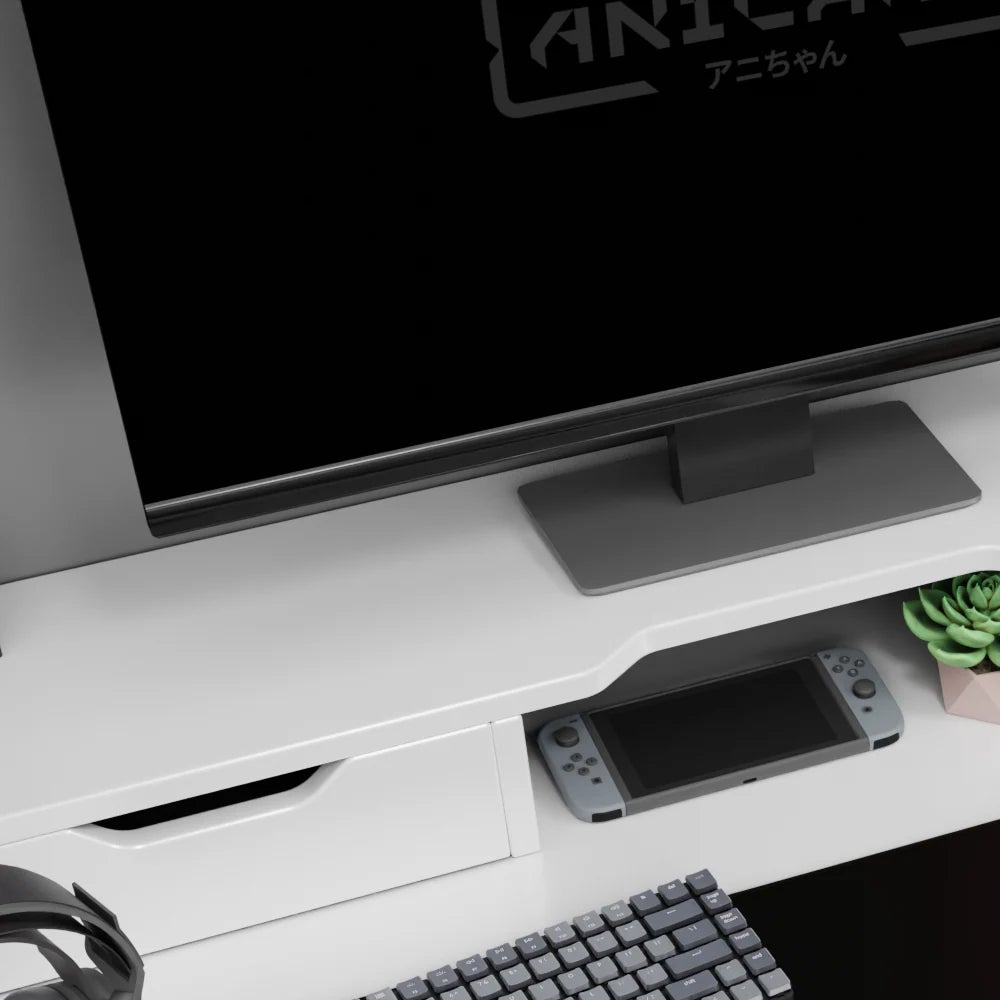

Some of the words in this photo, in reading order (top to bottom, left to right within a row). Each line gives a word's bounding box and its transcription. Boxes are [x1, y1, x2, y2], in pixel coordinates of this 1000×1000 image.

[705, 40, 847, 89] アニちゃん
